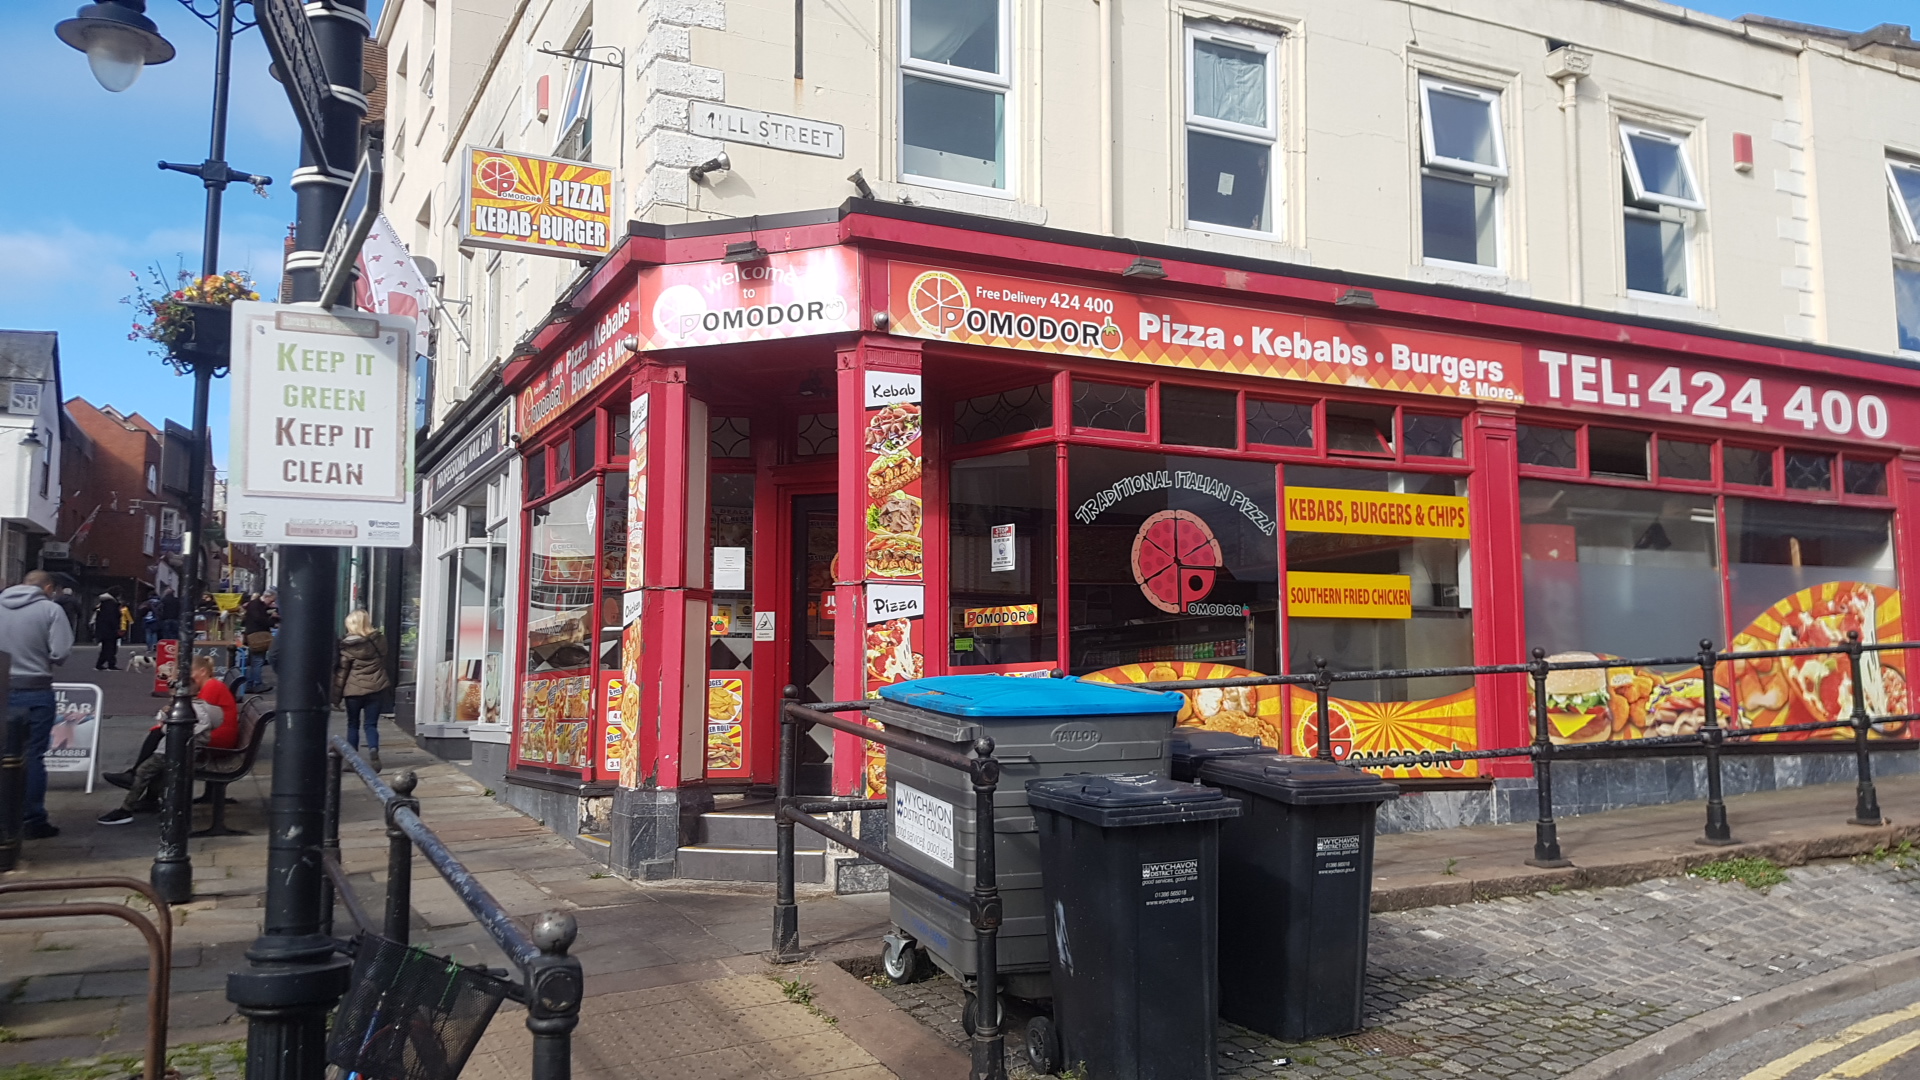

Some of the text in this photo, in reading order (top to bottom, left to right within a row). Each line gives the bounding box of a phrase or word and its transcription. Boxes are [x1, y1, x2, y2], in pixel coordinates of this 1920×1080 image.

[758, 121, 834, 147] STREET
[549, 177, 606, 214] PIZZA
[703, 265, 798, 295] welcome
[742, 287, 756, 298] to
[975, 286, 1114, 314] Free Delivery 424 400
[565, 301, 630, 374] Pizza Kebabs
[1138, 312, 1504, 383] Pizza Kebabs Burgers
[277, 342, 376, 376] KEEP IT
[571, 352, 607, 395] Burgers
[283, 384, 366, 412] GREEN
[871, 382, 915, 398] Kebab
[1458, 380, 1471, 396] &
[1538, 349, 1888, 439] TEL: 424 400
[631, 400, 647, 423] Burger
[275, 416, 374, 449] KEEP IT
[282, 459, 364, 486] CLEAN
[1074, 471, 1276, 536] TRADITIONAL ITALIAN PIZZA
[1289, 498, 1465, 528] KEBABS, BURGERS & CHIPS
[624, 600, 641, 618] Chicken
[873, 598, 918, 614] Pizza
[1291, 587, 1411, 606] SOUTHERN FRIED CHICKEN
[1055, 730, 1099, 742] TAYLOR
[903, 788, 952, 826] WYCHAVON
[903, 806, 953, 842] DISTRICT COUNCIL
[1150, 861, 1198, 871] WYCHAVON
[1174, 867, 1198, 875] COUNCIL
